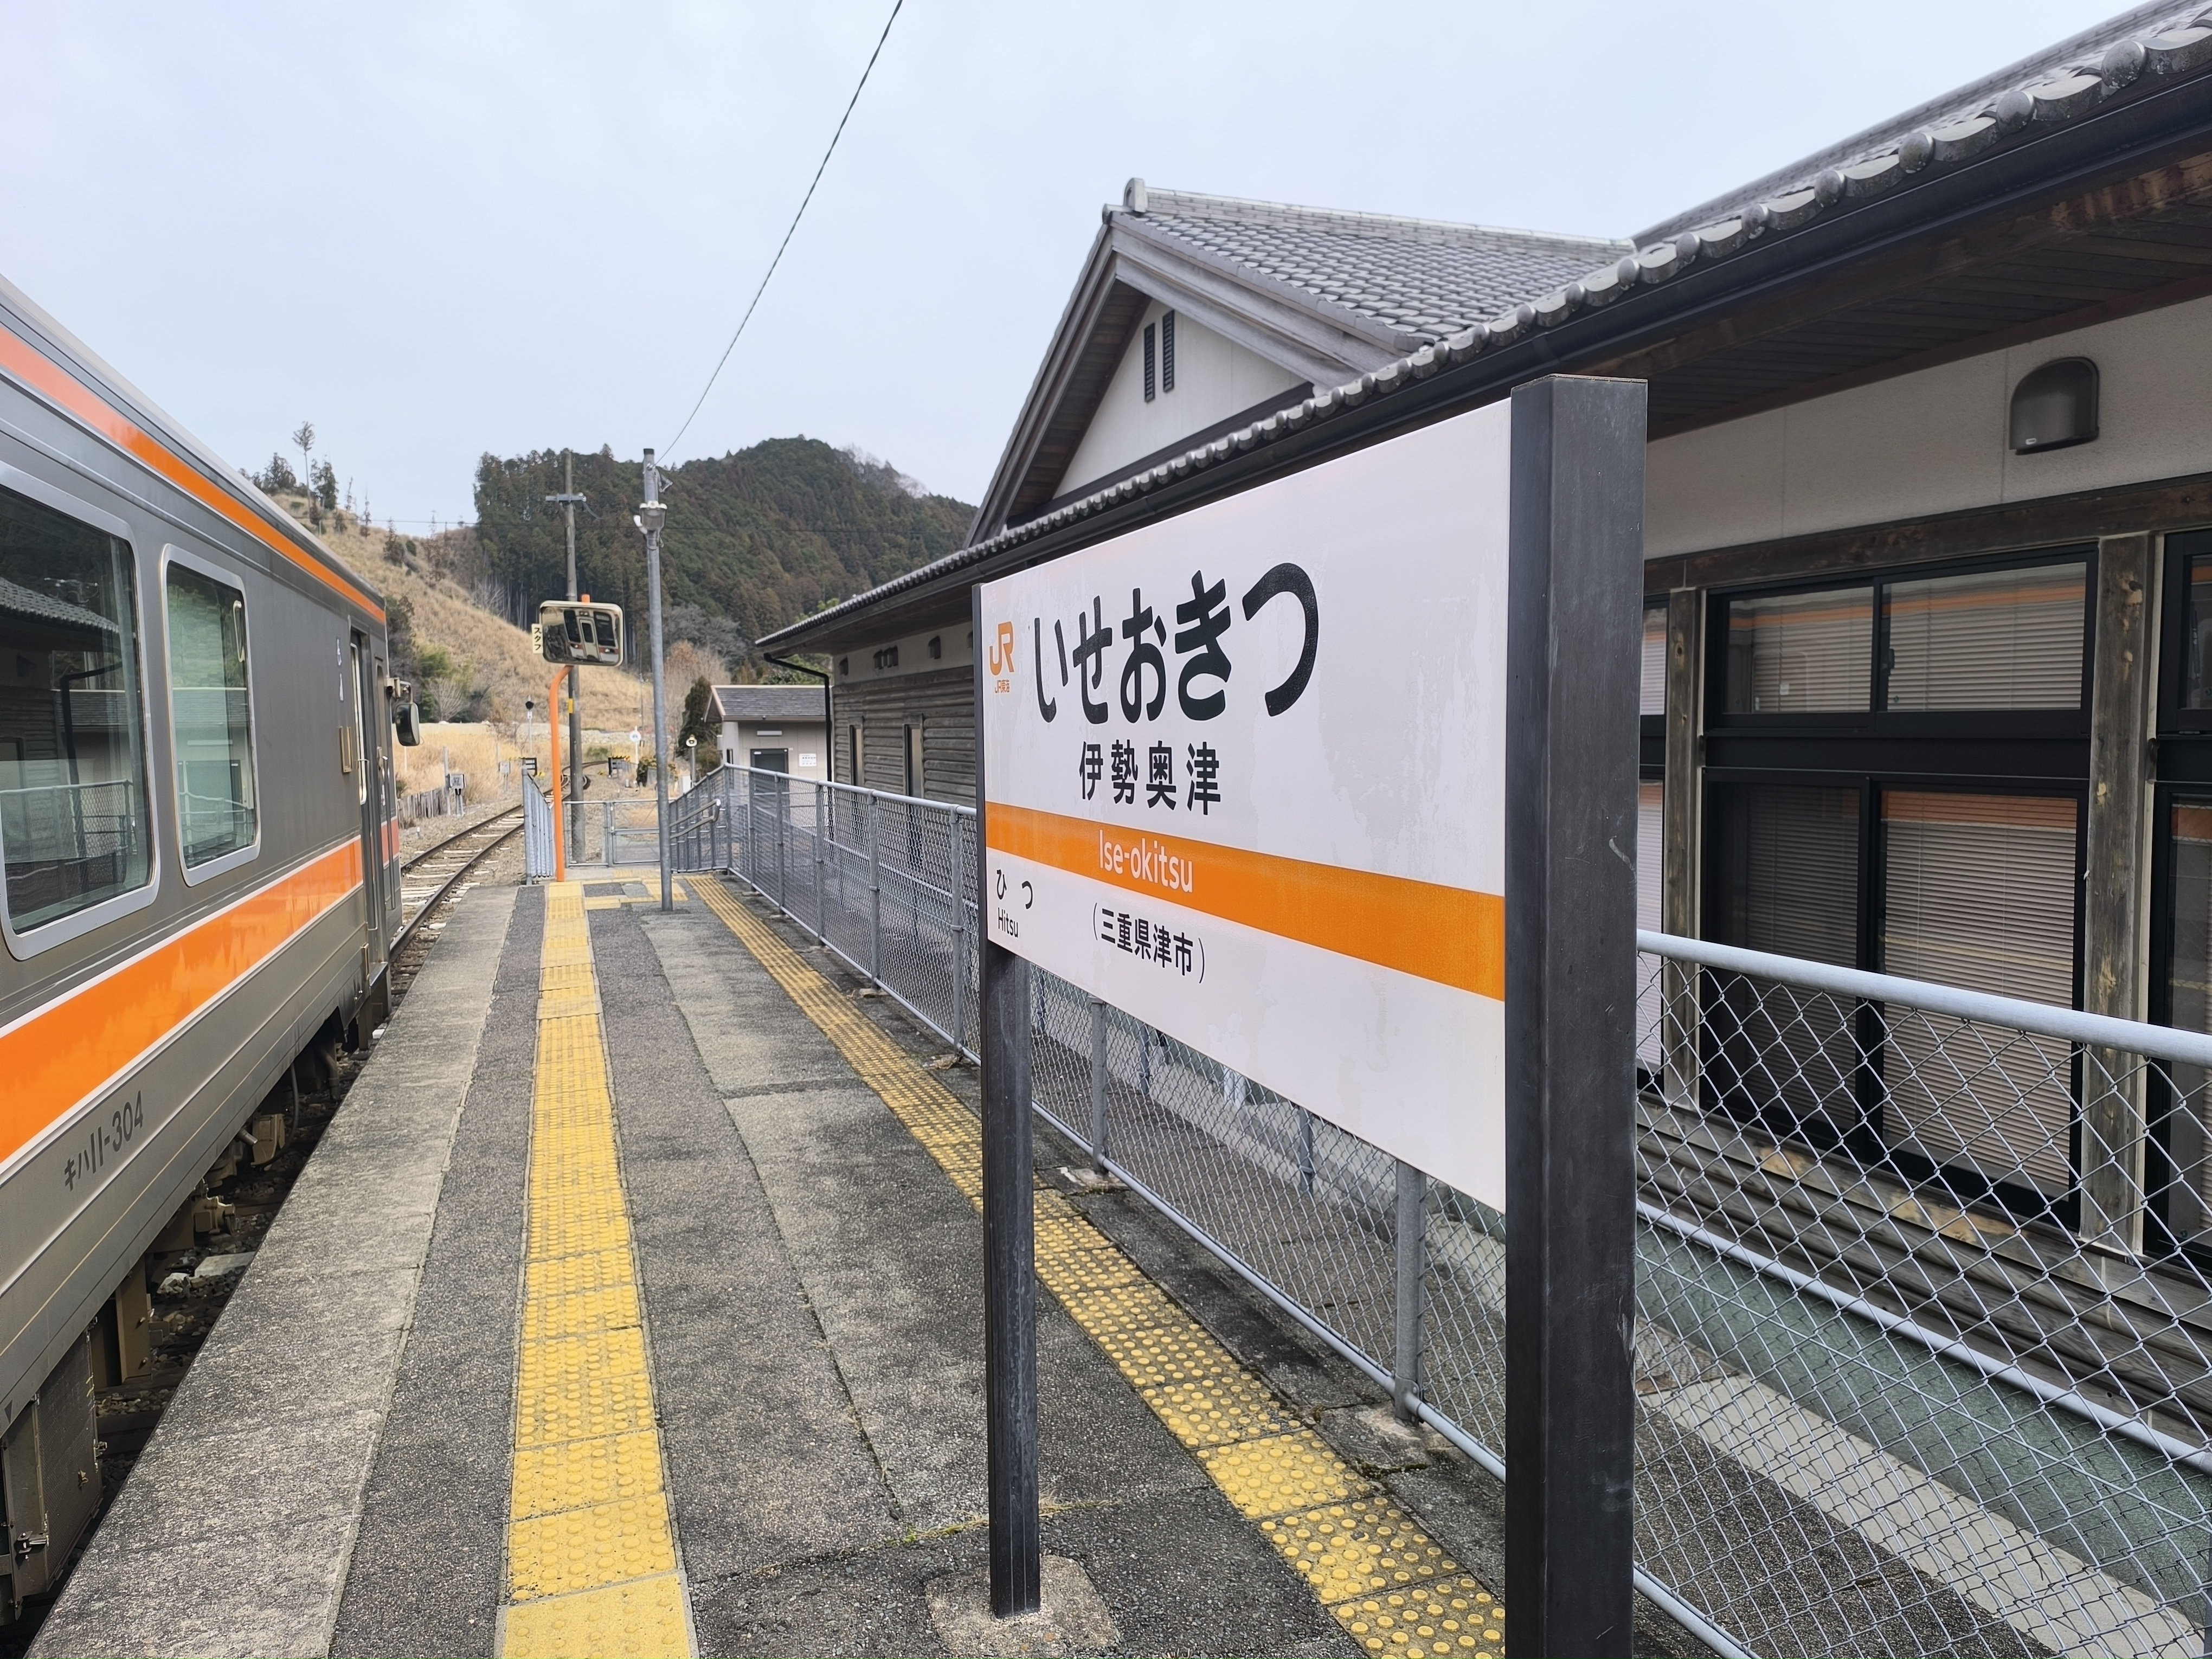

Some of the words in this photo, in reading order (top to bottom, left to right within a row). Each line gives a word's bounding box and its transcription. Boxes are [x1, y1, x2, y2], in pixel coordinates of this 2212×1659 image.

[989, 621, 1014, 676] JR
[1034, 562, 1319, 724] いせおきつ
[1079, 738, 1221, 815] 伊勢奥津
[1099, 829, 1193, 893] Ise-okitsu
[998, 907, 1018, 938] Hitsu
[64, 1090, 143, 1192] キハ11-304
